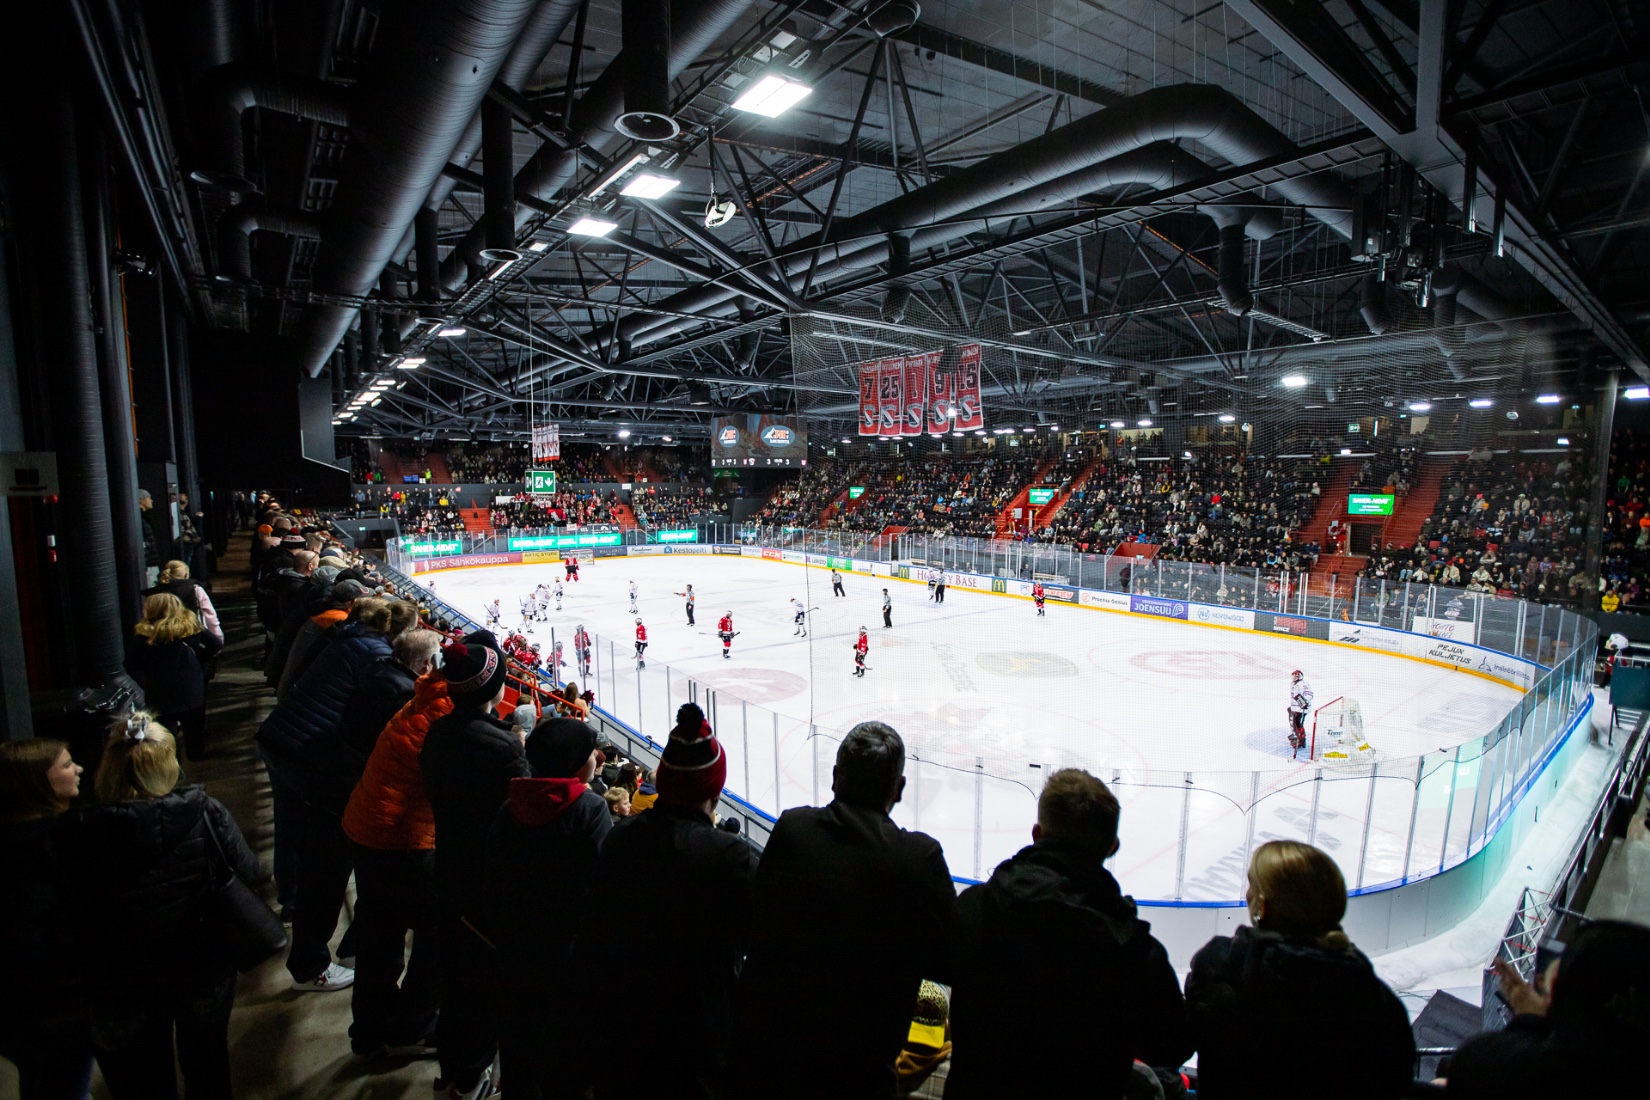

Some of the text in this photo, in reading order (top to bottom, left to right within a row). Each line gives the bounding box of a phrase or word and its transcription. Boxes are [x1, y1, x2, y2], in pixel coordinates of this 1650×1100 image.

[863, 376, 874, 400] 7
[881, 374, 900, 400] 25
[673, 547, 707, 555] Kestopelti
[763, 550, 781, 558] CCM
[430, 561, 447, 569] PKS
[956, 575, 978, 588] BASE
[1134, 603, 1172, 615] JOENSUU
[1437, 643, 1465, 655] PEJUN
[1429, 649, 1472, 664] KULJETUS
